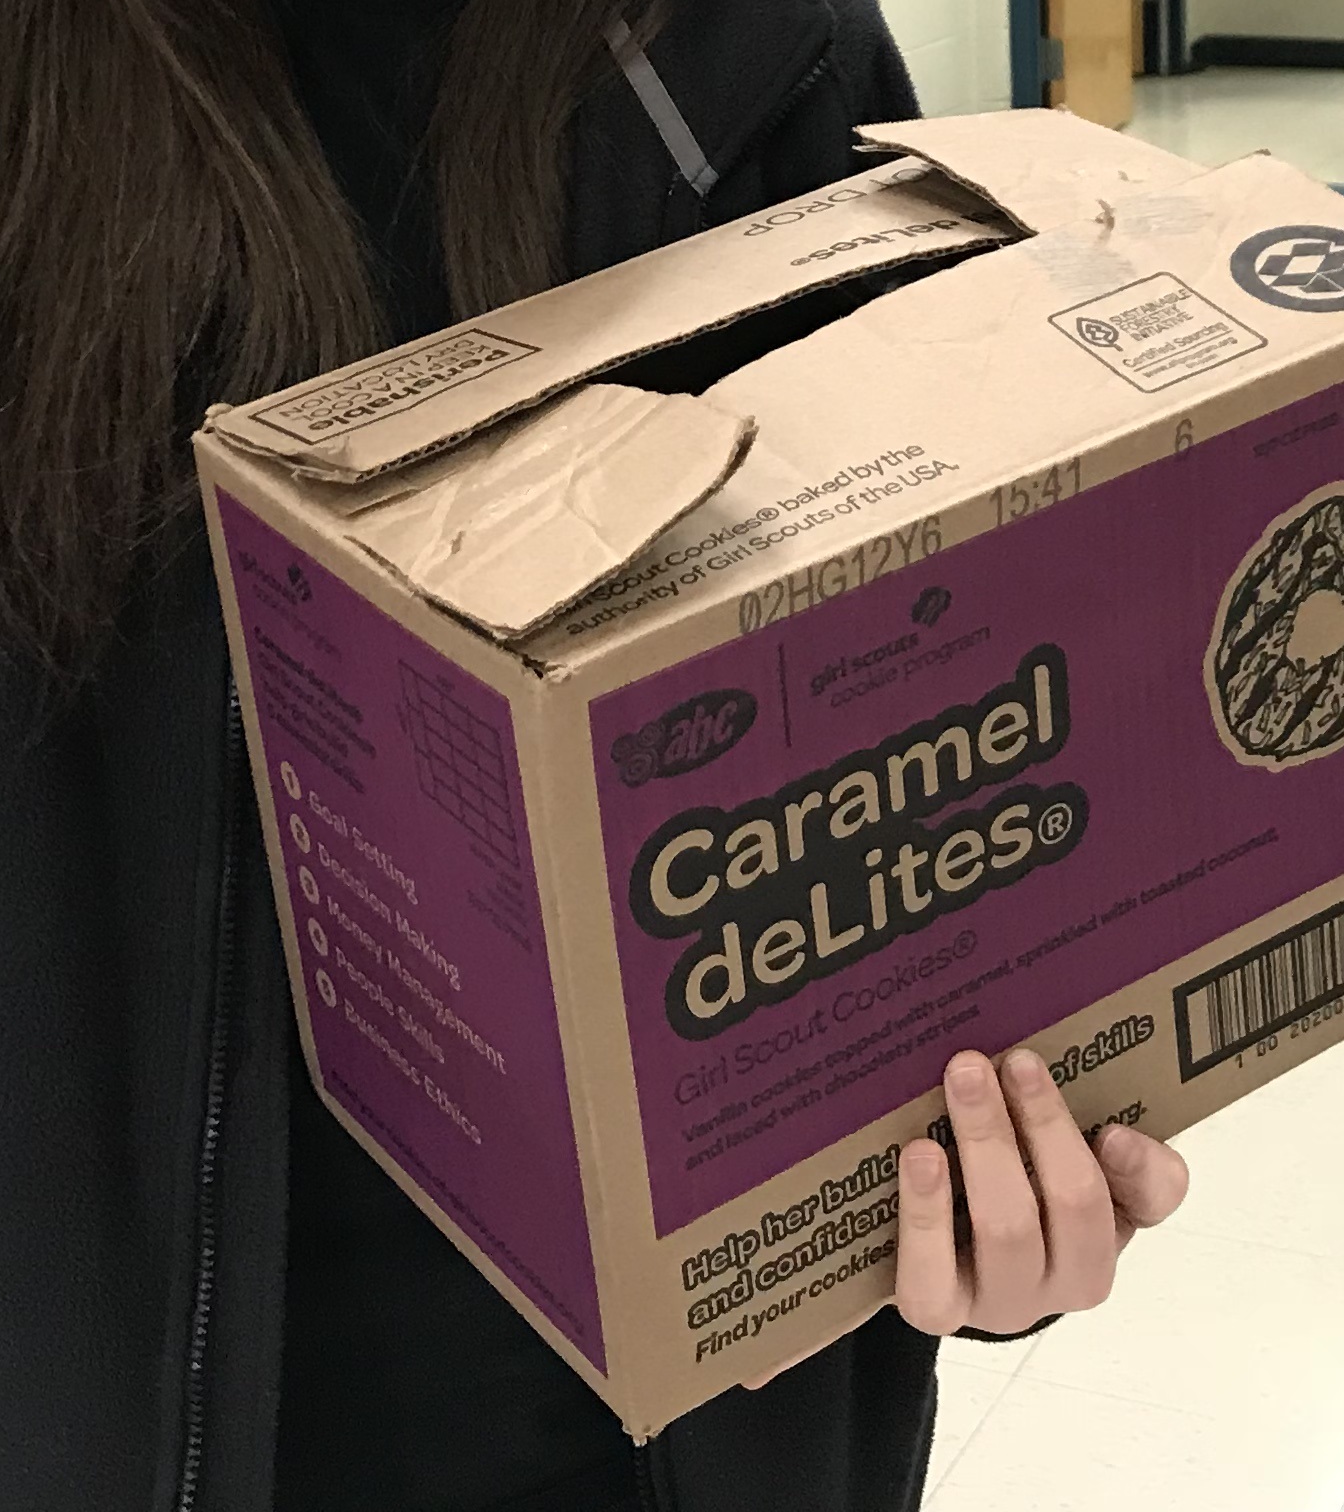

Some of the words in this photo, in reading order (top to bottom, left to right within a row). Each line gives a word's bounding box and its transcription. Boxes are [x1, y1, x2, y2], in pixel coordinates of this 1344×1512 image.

[743, 188, 867, 236] DROP
[425, 338, 474, 363] DRY
[1109, 288, 1192, 324] SUSTAINABLE
[1120, 303, 1181, 334] FORESTRY
[279, 359, 422, 418] LOCATION
[290, 392, 373, 422] COOL
[308, 349, 510, 431] Perishable
[593, 552, 670, 601] Scout
[777, 470, 855, 512] baked
[854, 456, 883, 483] by
[881, 443, 925, 471] the
[988, 456, 1081, 527] 15:41
[1174, 418, 1195, 461] 6
[565, 580, 681, 635] authority
[679, 562, 708, 585] of
[705, 543, 752, 571] Girl
[754, 506, 836, 552] Scouts
[833, 496, 861, 515] of
[859, 478, 903, 505] the
[902, 458, 960, 488] USA.
[810, 658, 848, 696] girl
[850, 632, 920, 670] scouts
[830, 664, 897, 708] cookie
[904, 626, 990, 678] program
[666, 700, 737, 765] abc
[649, 664, 1056, 917] Caramel
[309, 790, 348, 837] Goal
[352, 826, 419, 906] Setting
[318, 841, 393, 924] Decision
[395, 909, 462, 992] Making
[326, 895, 382, 964] Money
[386, 949, 507, 1075] Management
[335, 946, 395, 1016] People
[397, 1005, 446, 1064] Skills
[682, 1101, 748, 1142] Vanilla
[751, 1061, 822, 1108] cookies
[1016, 915, 1097, 968] sprinkled
[1100, 896, 1137, 925] with
[1140, 859, 1205, 905] toasted
[344, 997, 420, 1086] Business
[424, 1075, 482, 1145] Ethics
[673, 1055, 729, 1106] Girl
[735, 1008, 828, 1075] Scout
[1235, 1054, 1244, 1069] 1
[1257, 1035, 1279, 1057] 00
[682, 1228, 761, 1291] Help
[761, 1194, 819, 1247] her
[819, 1143, 900, 1213] build
[1081, 1013, 1155, 1079] skills
[685, 1144, 724, 1172] and
[725, 1110, 778, 1155] laced
[781, 1088, 823, 1120] with
[687, 1270, 754, 1329] and
[755, 1190, 900, 1291] confidenc
[695, 1315, 748, 1364] Find
[751, 1287, 808, 1336] your
[808, 1238, 896, 1298] cookies
